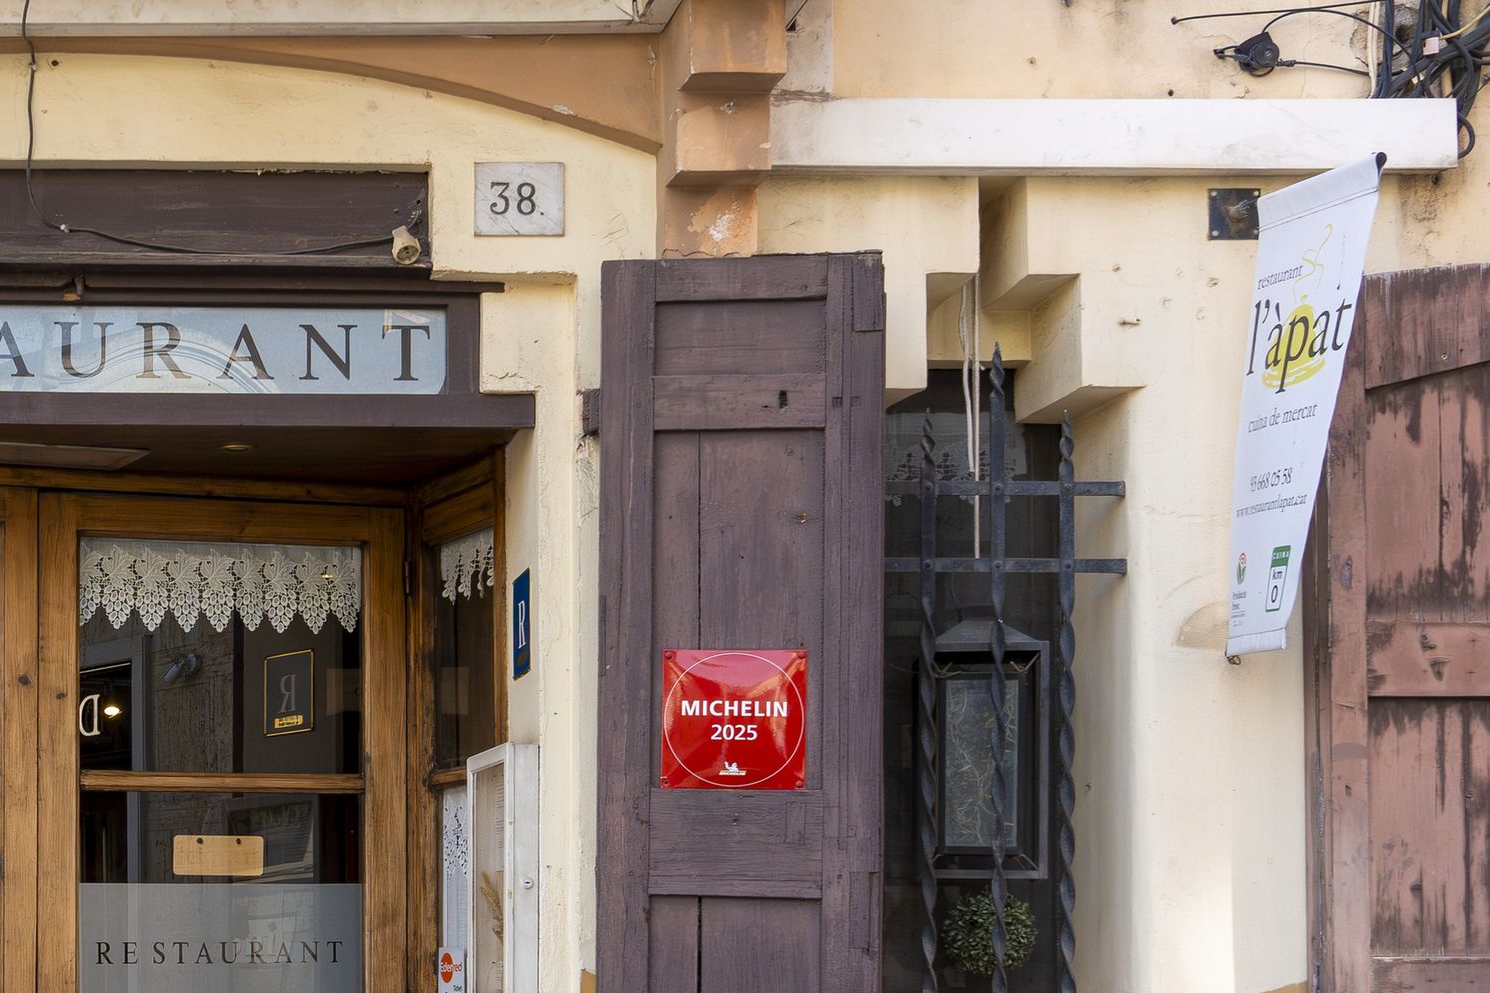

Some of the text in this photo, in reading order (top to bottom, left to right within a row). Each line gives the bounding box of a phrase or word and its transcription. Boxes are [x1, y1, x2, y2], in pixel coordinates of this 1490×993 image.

[1257, 264, 1304, 290] restaurant
[1248, 404, 1318, 433] cuina de mercat
[1272, 571, 1283, 580] km
[518, 600, 526, 649] R
[681, 700, 789, 718] MICHELIN
[710, 724, 758, 741] 2025
[95, 940, 344, 966] RESTAURANT
